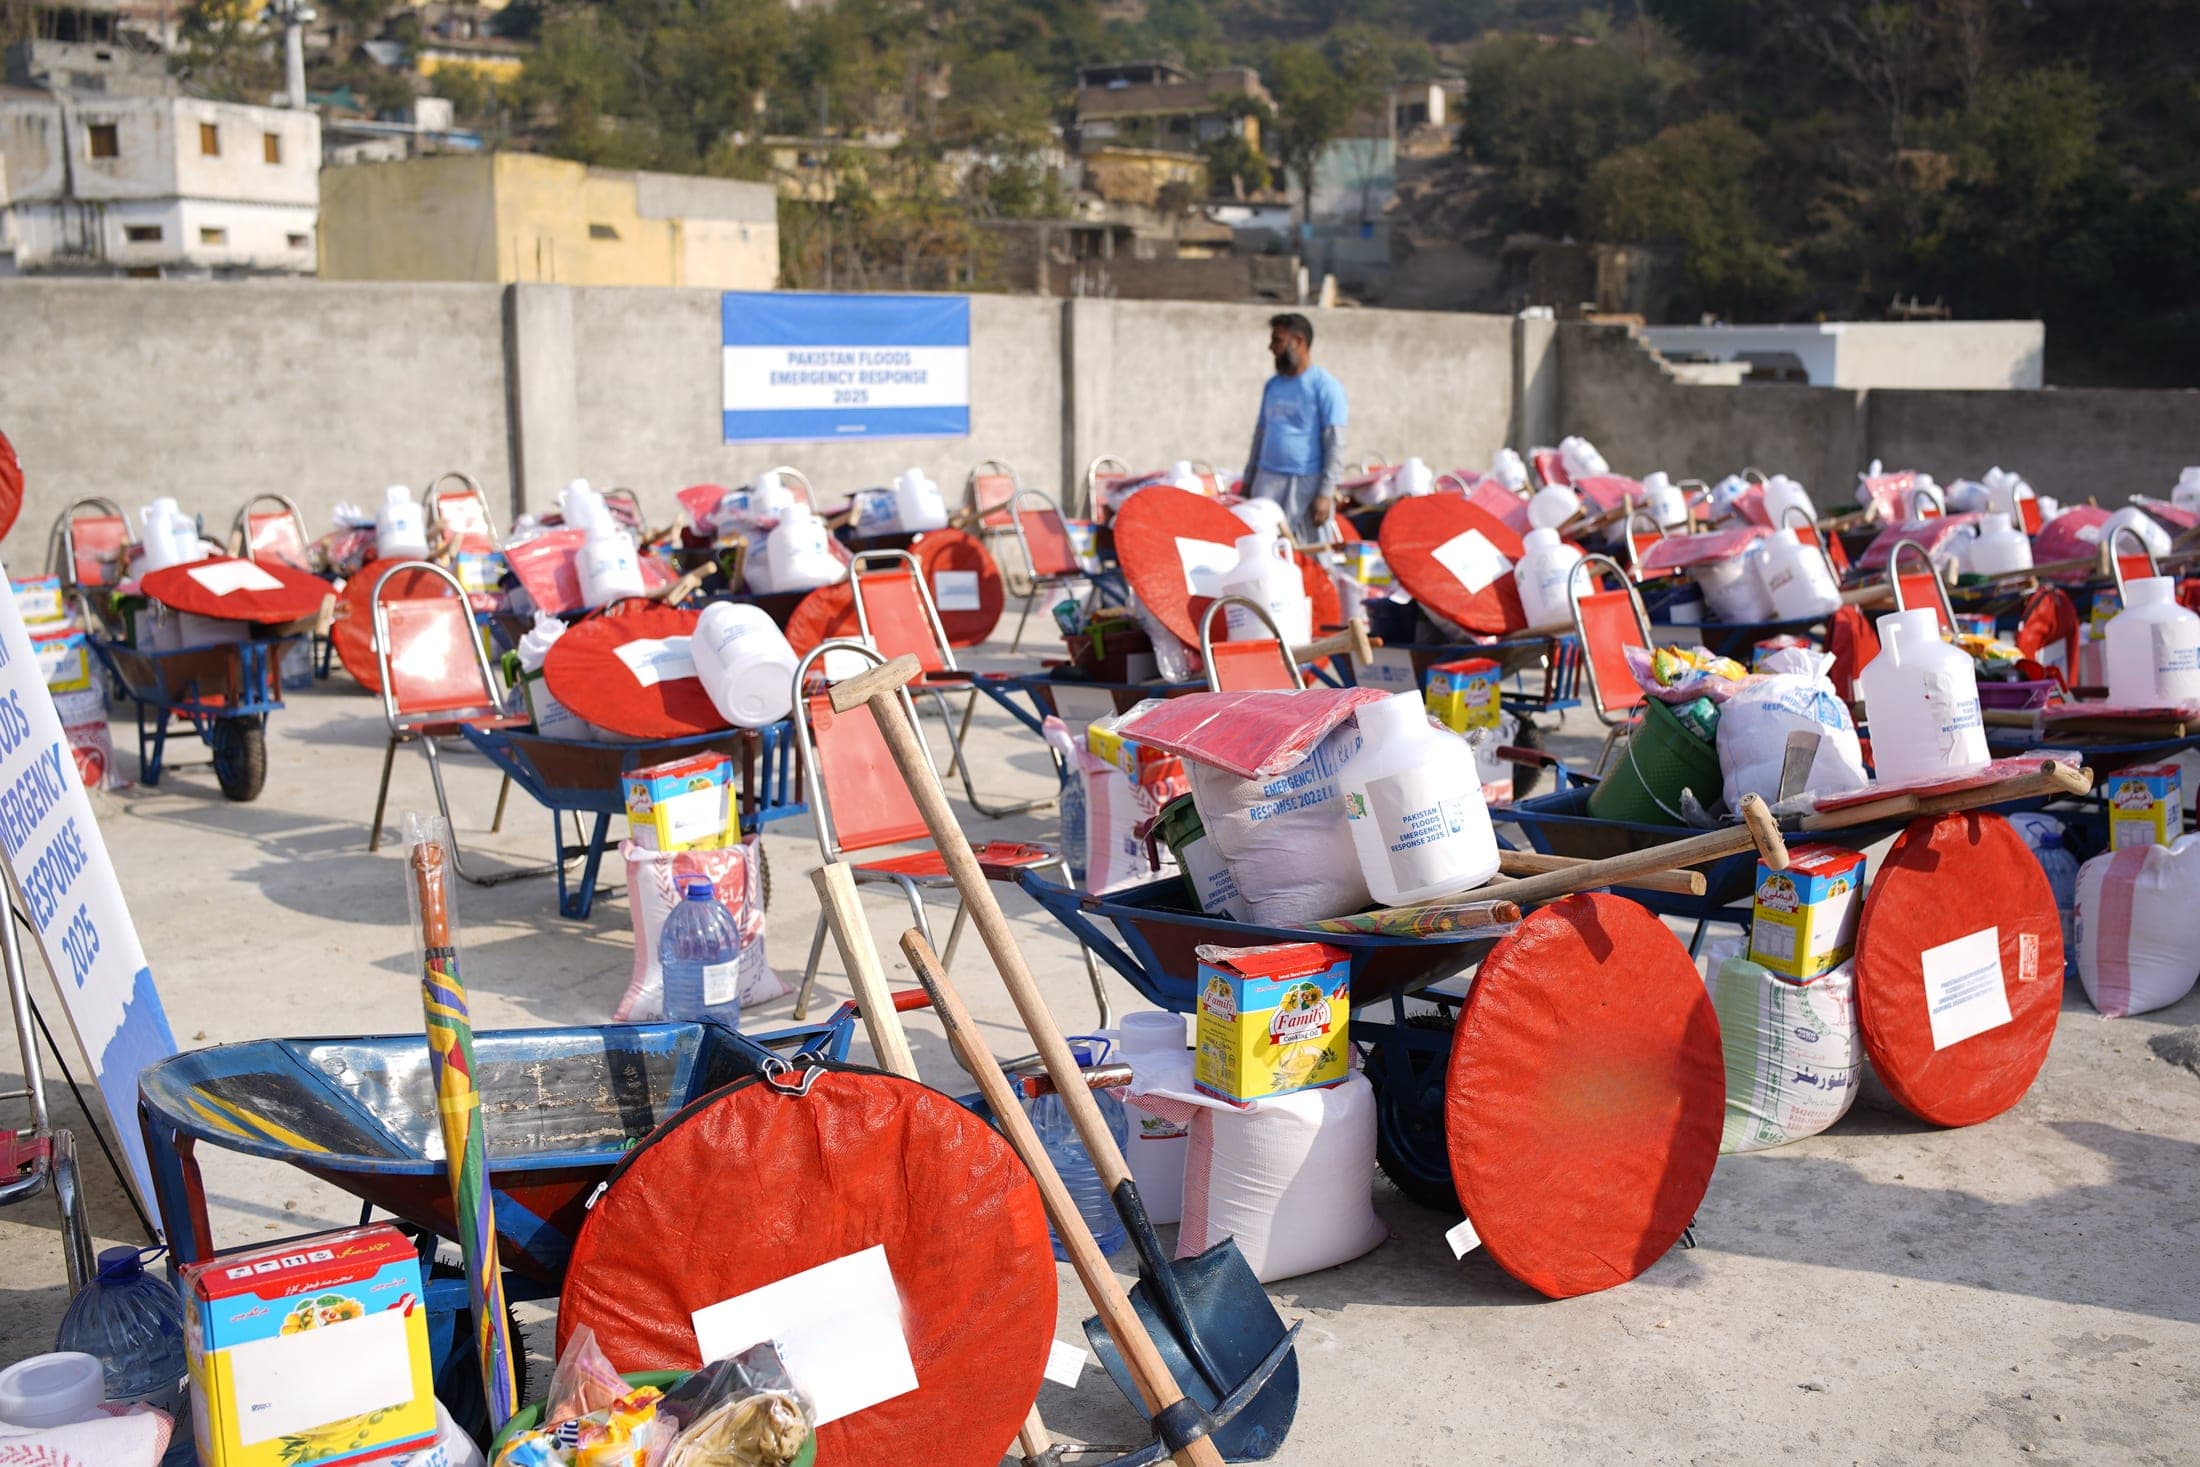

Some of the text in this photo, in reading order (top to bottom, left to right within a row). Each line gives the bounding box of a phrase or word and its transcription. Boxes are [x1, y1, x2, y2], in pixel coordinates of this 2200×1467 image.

[787, 351, 912, 367] PAKISTAN FLOODS
[769, 369, 928, 386] EMERGENCY RESPONSE
[833, 389, 869, 404] 2025
[1263, 767, 1316, 798] EMERGENCY
[0, 742, 67, 863] MERGENCY
[1402, 807, 1438, 824] PAKISTAN
[1411, 815, 1441, 830] FLOODS
[1390, 831, 1446, 852] RESPONSE 2025
[1400, 823, 1442, 842] EMERGENCY
[62, 902, 101, 991] 2025
[1206, 992, 1233, 1012] Family
[1278, 1008, 1323, 1030] Family
[1283, 1032, 1308, 1042] Cooking
